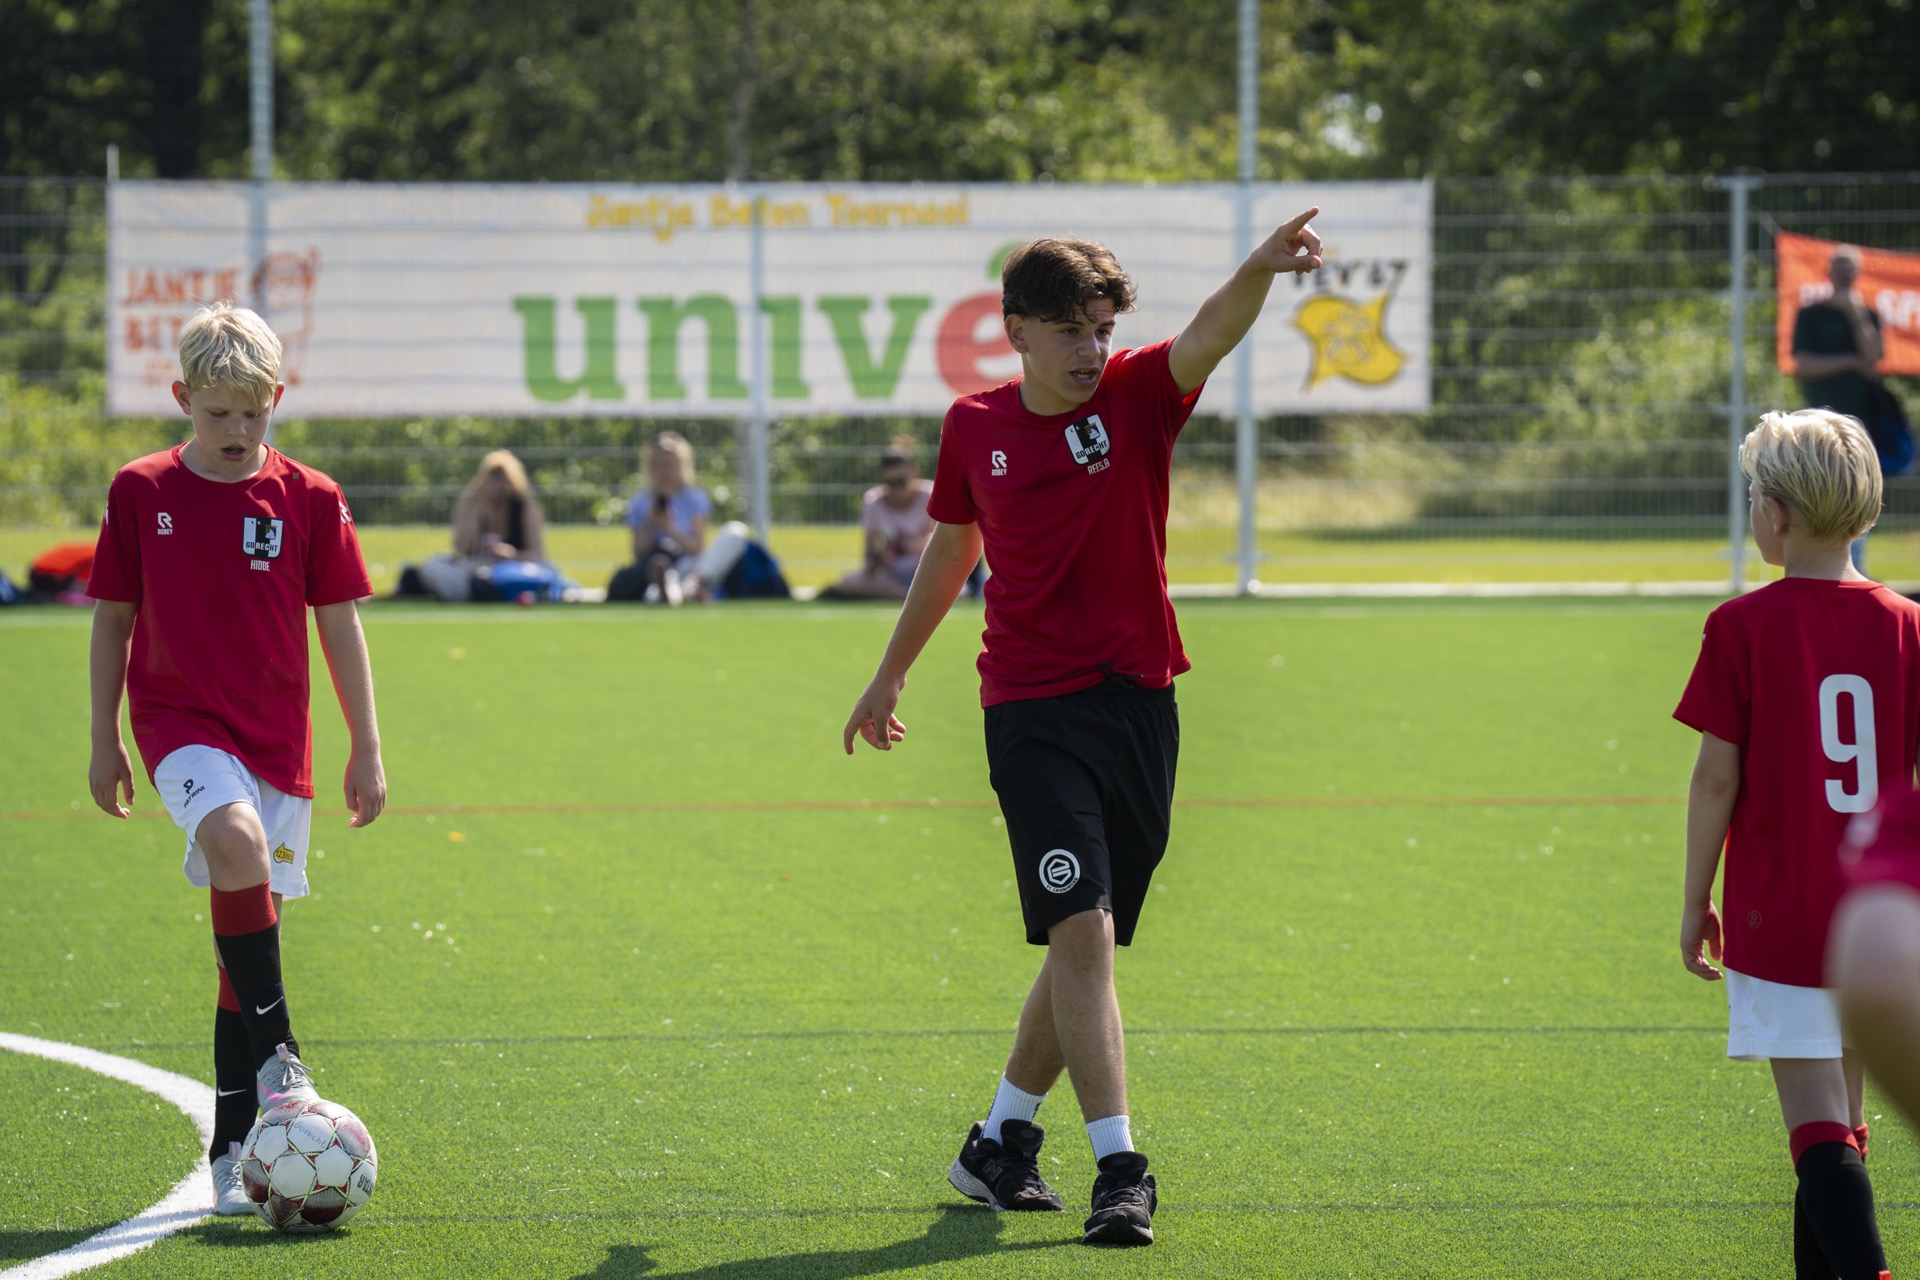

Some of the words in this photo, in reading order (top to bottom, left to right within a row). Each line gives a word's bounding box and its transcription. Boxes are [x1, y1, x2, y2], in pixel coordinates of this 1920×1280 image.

[125, 315, 186, 352] BET
[1075, 440, 1108, 460] GORECHT
[991, 468, 1008, 476] ROBEY
[245, 541, 279, 552] GORECHT
[250, 559, 271, 572] HIDDE
[1818, 673, 1879, 813] 9
